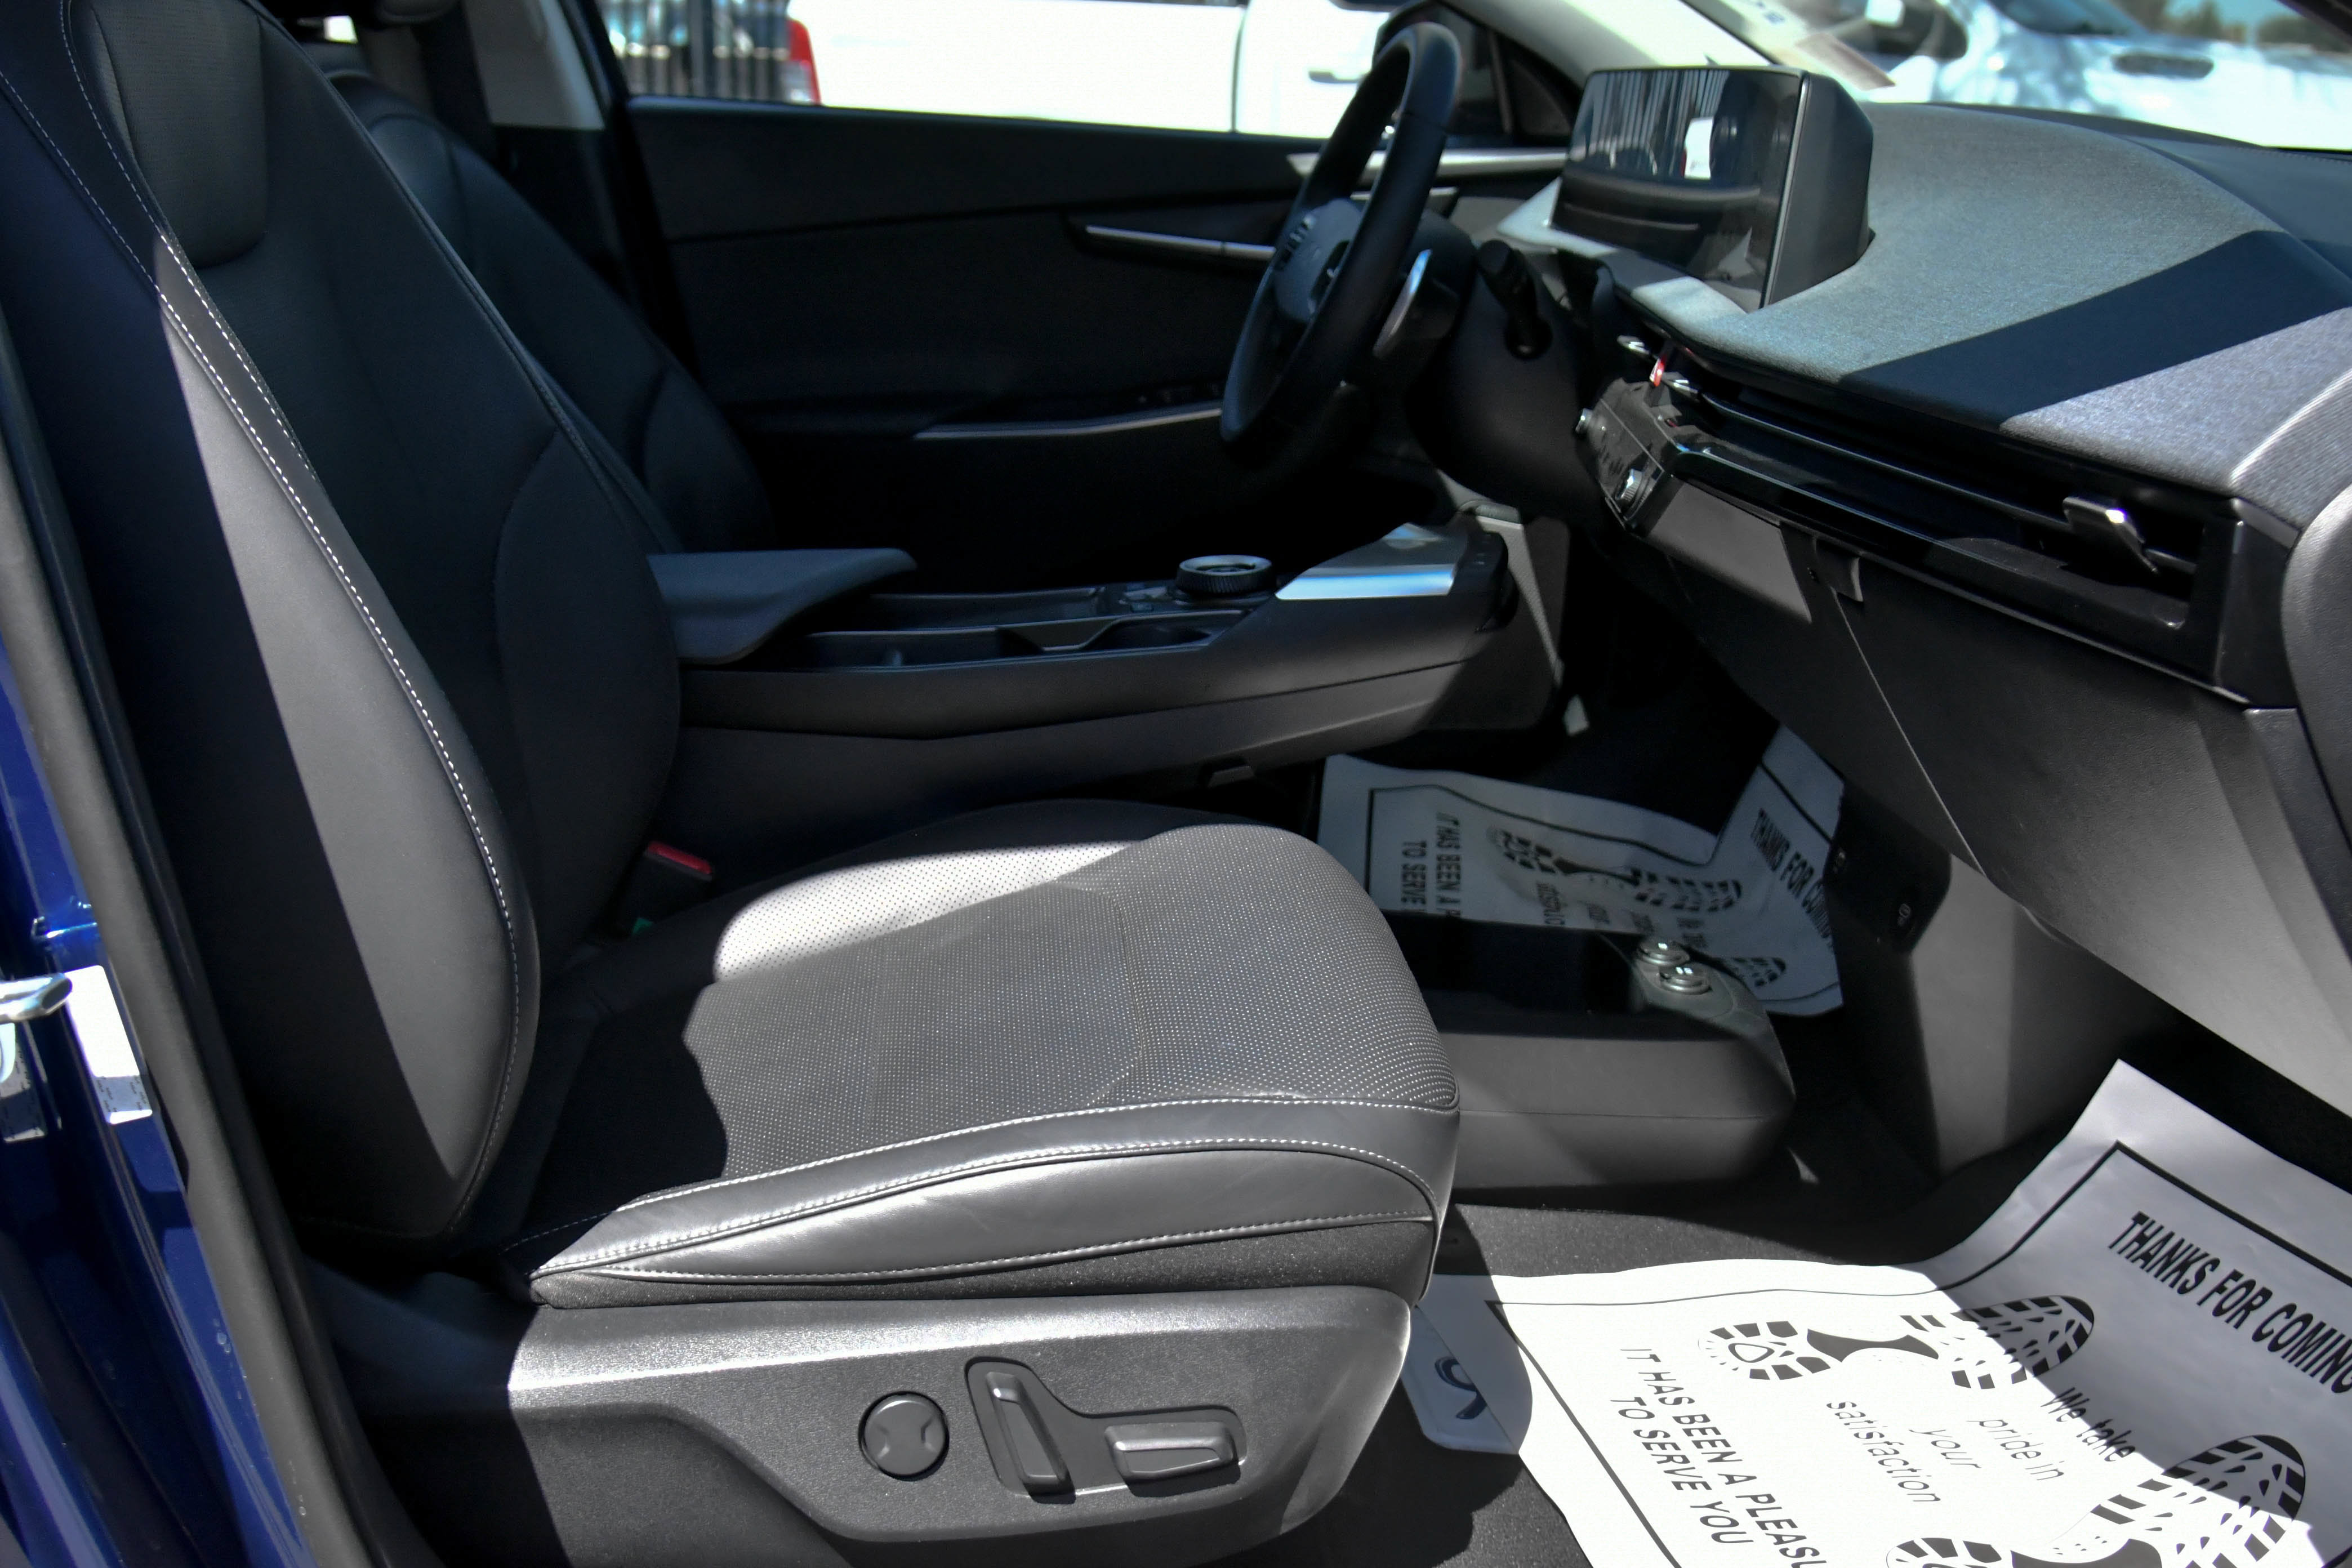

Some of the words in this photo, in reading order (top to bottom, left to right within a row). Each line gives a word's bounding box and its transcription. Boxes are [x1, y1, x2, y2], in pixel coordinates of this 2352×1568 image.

[1402, 841, 1427, 858] TO
[1401, 863, 1427, 905] SERVE
[1436, 854, 1461, 892] BEEN
[1780, 851, 1814, 899] FOR
[1437, 896, 1461, 904] A
[2108, 1211, 2221, 1295] THANKS
[2197, 1269, 2273, 1330] FOR
[1620, 1348, 1661, 1363] IT
[1638, 1371, 1695, 1406] HAS
[1672, 1414, 1743, 1464] BEEN
[2040, 1386, 2090, 1423] We
[2076, 1418, 2136, 1462] take
[1826, 1401, 1941, 1502] satisfaction
[1909, 1429, 1982, 1468] your
[1966, 1419, 2043, 1459] pride
[2025, 1460, 2065, 1481] in
[1610, 1396, 1655, 1420] TO
[1633, 1429, 1713, 1491] SERVE
[1689, 1500, 1754, 1544] YOU
[1717, 1473, 1758, 1485] A
